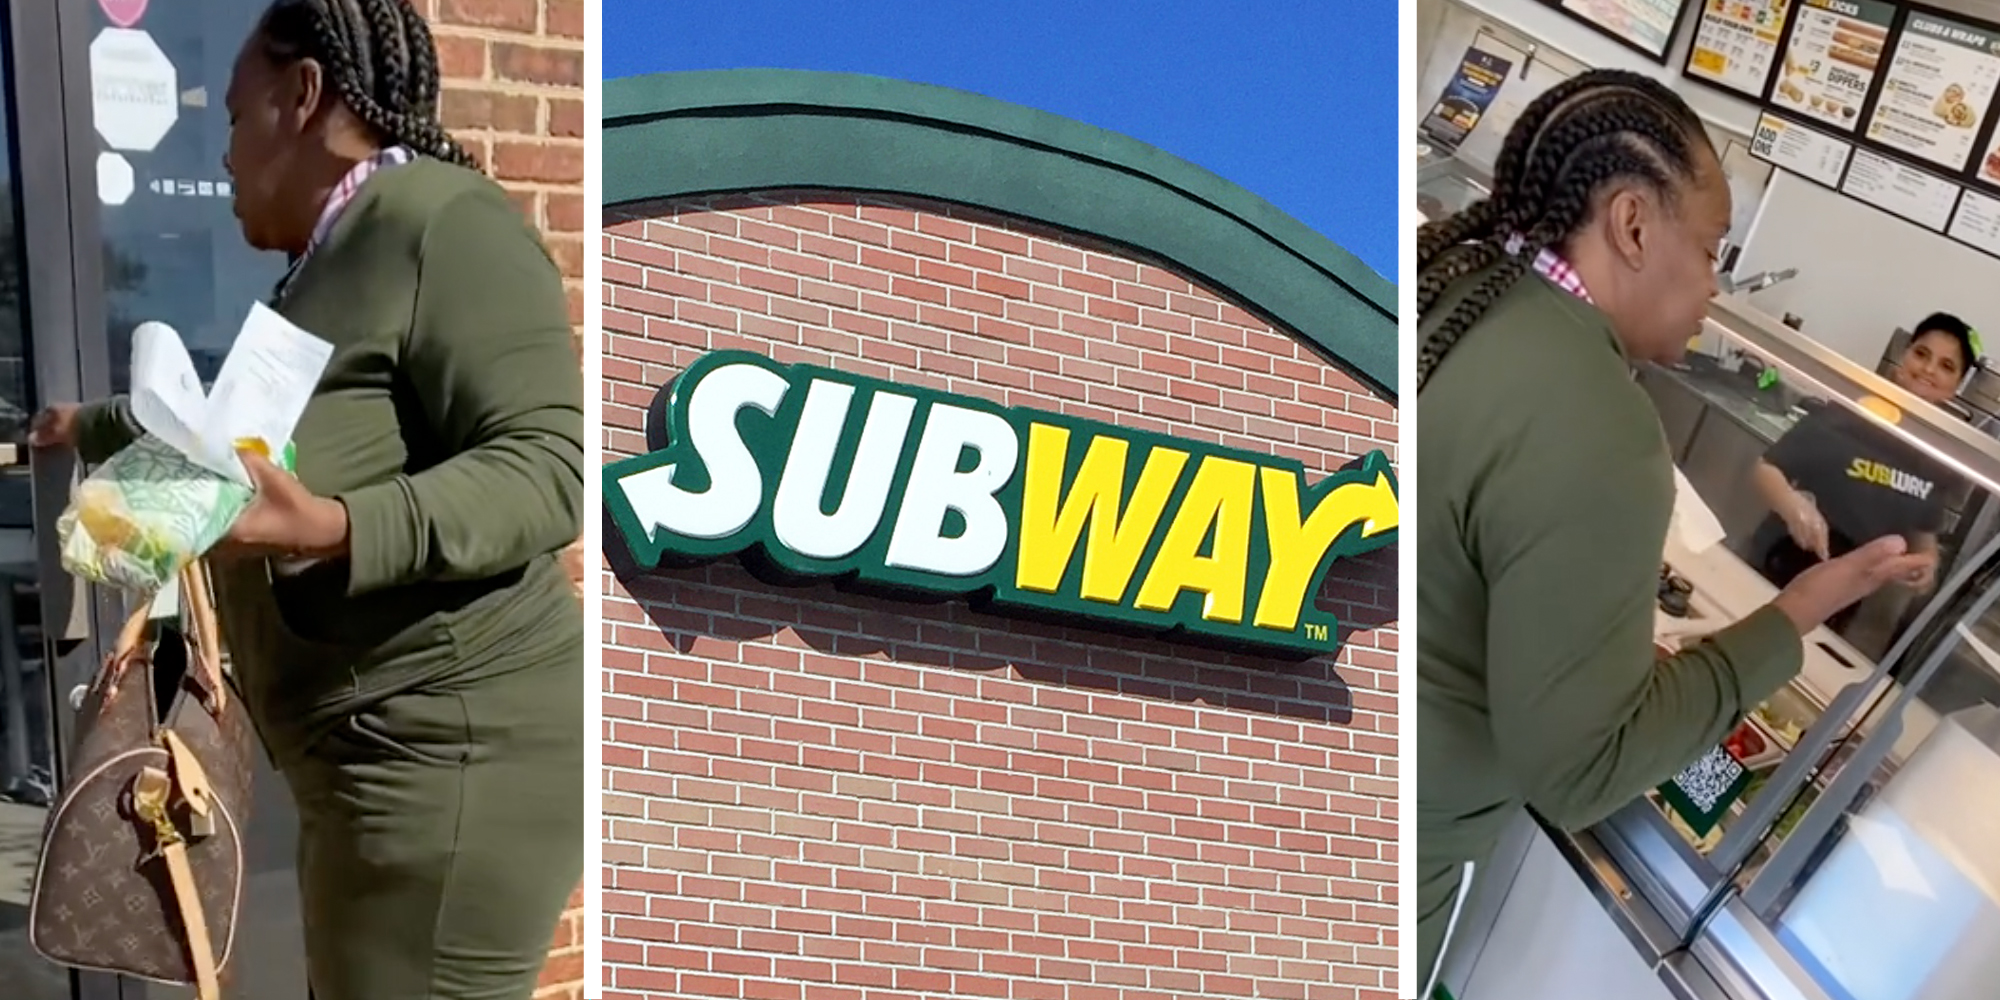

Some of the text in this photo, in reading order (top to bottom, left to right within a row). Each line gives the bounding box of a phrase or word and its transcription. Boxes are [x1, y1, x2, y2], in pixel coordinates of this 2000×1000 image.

[1912, 18, 1942, 36] CLUBS
[1950, 28, 1987, 47] WRAPS
[1827, 71, 1867, 93] DIPPERS
[1758, 126, 1777, 142] ADD
[1754, 139, 1773, 156] ONS
[1845, 457, 1934, 500] SUBWAY
[617, 363, 1399, 631] SUBWAY
[1304, 623, 1328, 641] TM
